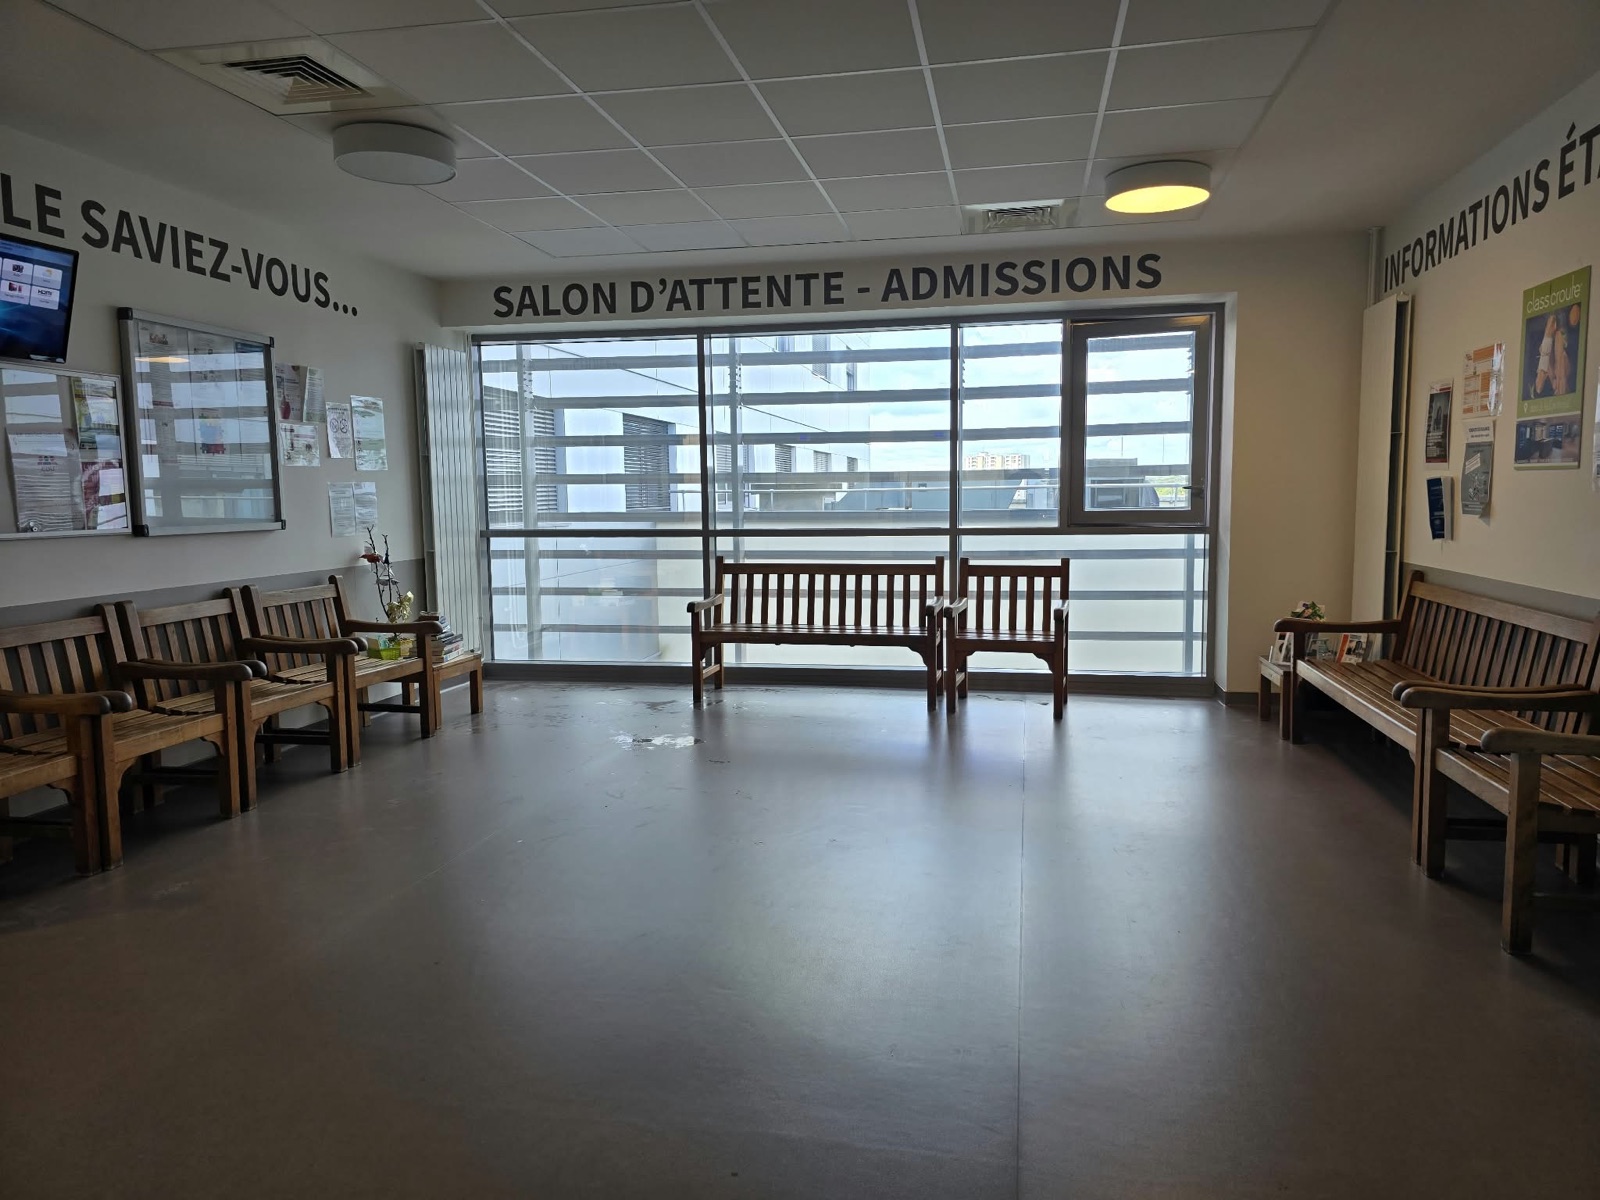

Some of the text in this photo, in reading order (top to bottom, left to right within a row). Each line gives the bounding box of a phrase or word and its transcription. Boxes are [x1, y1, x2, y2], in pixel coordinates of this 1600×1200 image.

[0, 172, 358, 317] LE SAVIEZ-VOUS...
[1383, 121, 1600, 293] INFORMATIONS ÉT
[493, 281, 618, 318] SALON
[630, 271, 845, 313] D’ATTENTE
[881, 253, 1163, 302] ADMISSIONS
